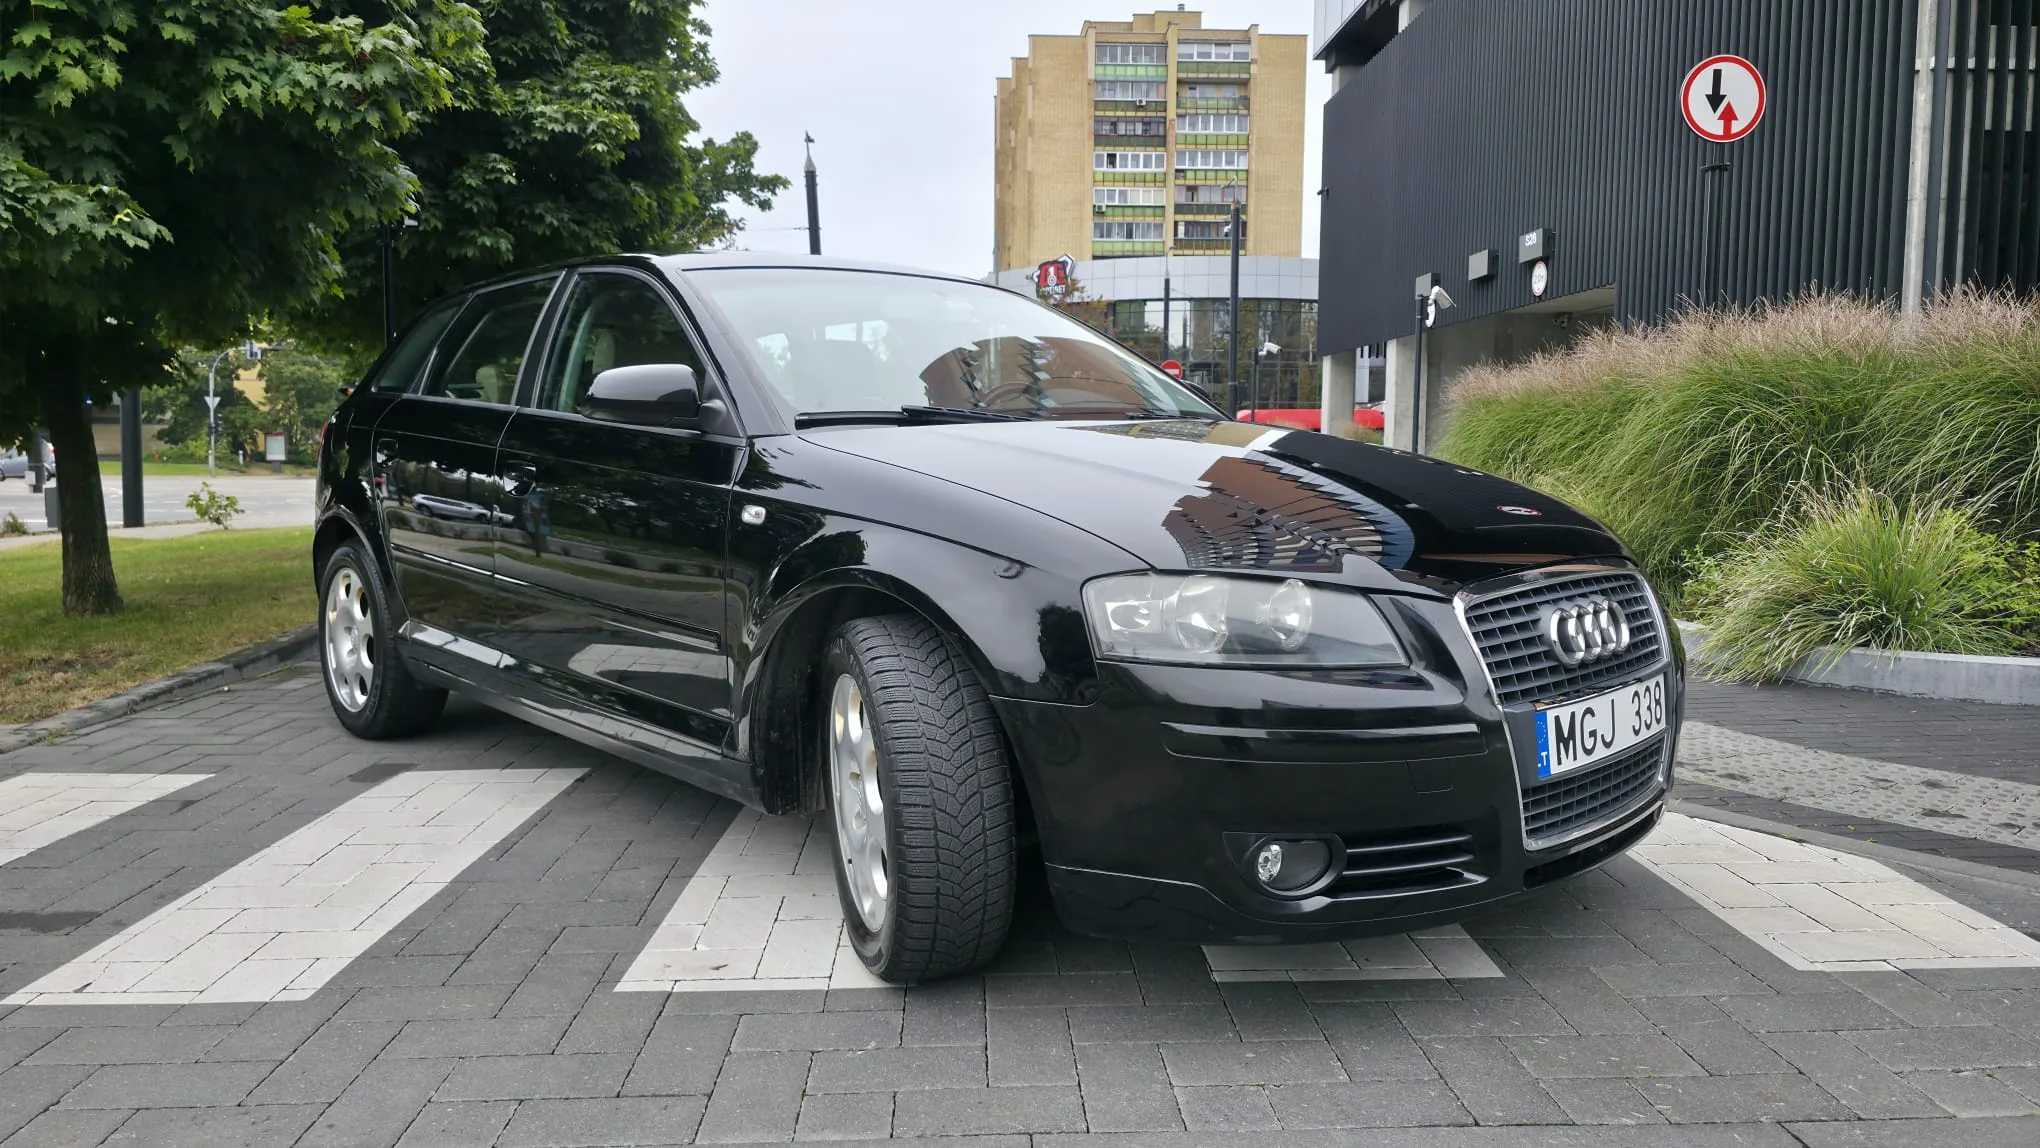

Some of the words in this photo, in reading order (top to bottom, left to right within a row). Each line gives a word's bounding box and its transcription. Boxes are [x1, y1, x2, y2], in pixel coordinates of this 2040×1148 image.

[1554, 698, 1615, 766] MGJ
[1631, 680, 1662, 736] 338
[1537, 752, 1548, 768] T
